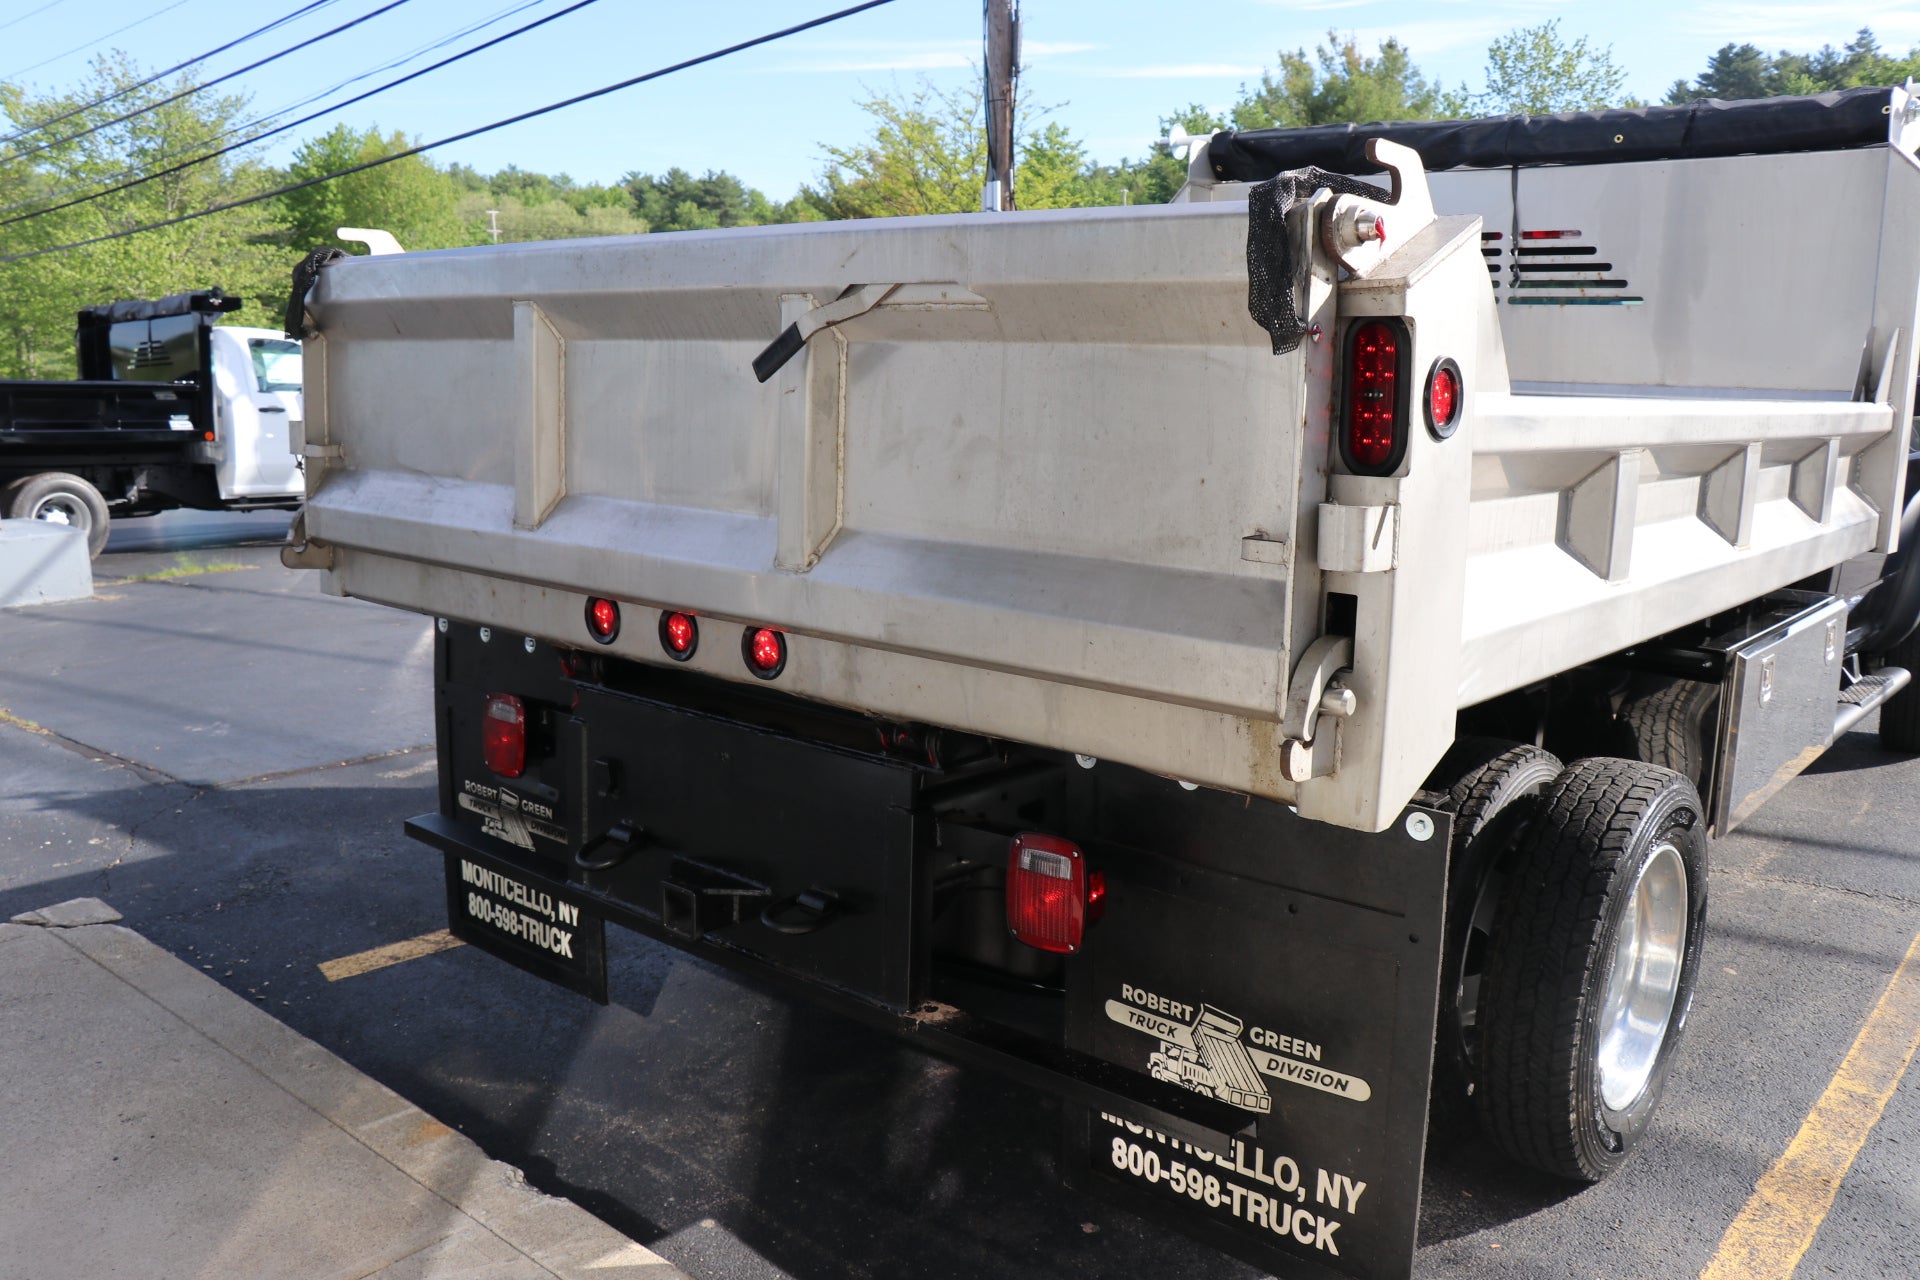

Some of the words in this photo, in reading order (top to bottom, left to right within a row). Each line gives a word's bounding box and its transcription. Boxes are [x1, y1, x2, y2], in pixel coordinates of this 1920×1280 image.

[464, 779, 498, 800] ROBERT
[521, 799, 553, 820] GREEN
[469, 798, 492, 814] TRUCK
[461, 859, 556, 923] MONTICELLO,
[558, 900, 579, 928] NY
[468, 892, 574, 959] 800-598-TRUCK
[1122, 983, 1194, 1022] ROBERT
[1249, 1026, 1322, 1062] GREEN
[1128, 1011, 1178, 1039] TRUCK
[1266, 1058, 1350, 1093] DIVISION
[1111, 1136, 1342, 1257] 800-598-TRUCK
[1316, 1168, 1367, 1215] NY
